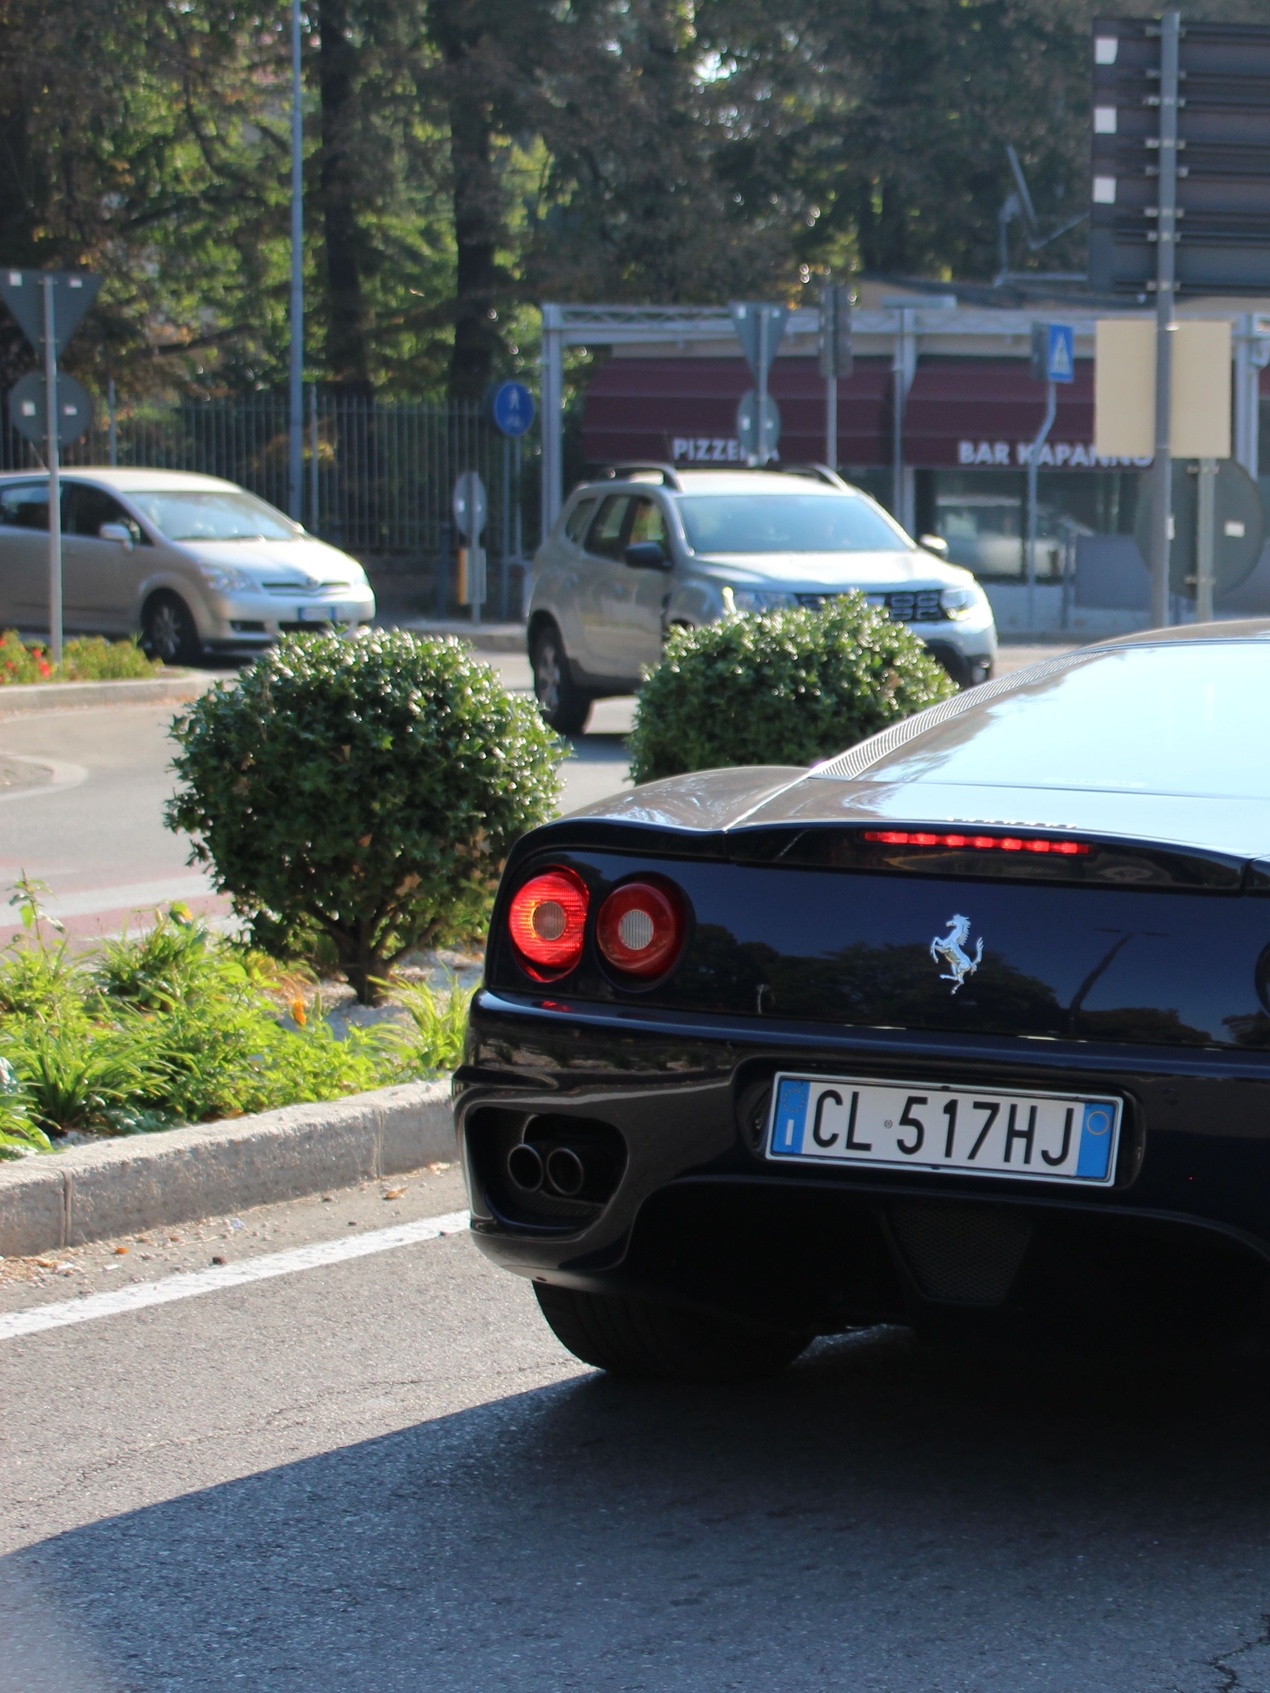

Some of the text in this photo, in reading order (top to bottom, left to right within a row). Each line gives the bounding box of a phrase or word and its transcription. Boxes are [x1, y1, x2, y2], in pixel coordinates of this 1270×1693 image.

[958, 441, 1010, 465] BAR
[812, 1089, 1075, 1167] CL 517HJ
